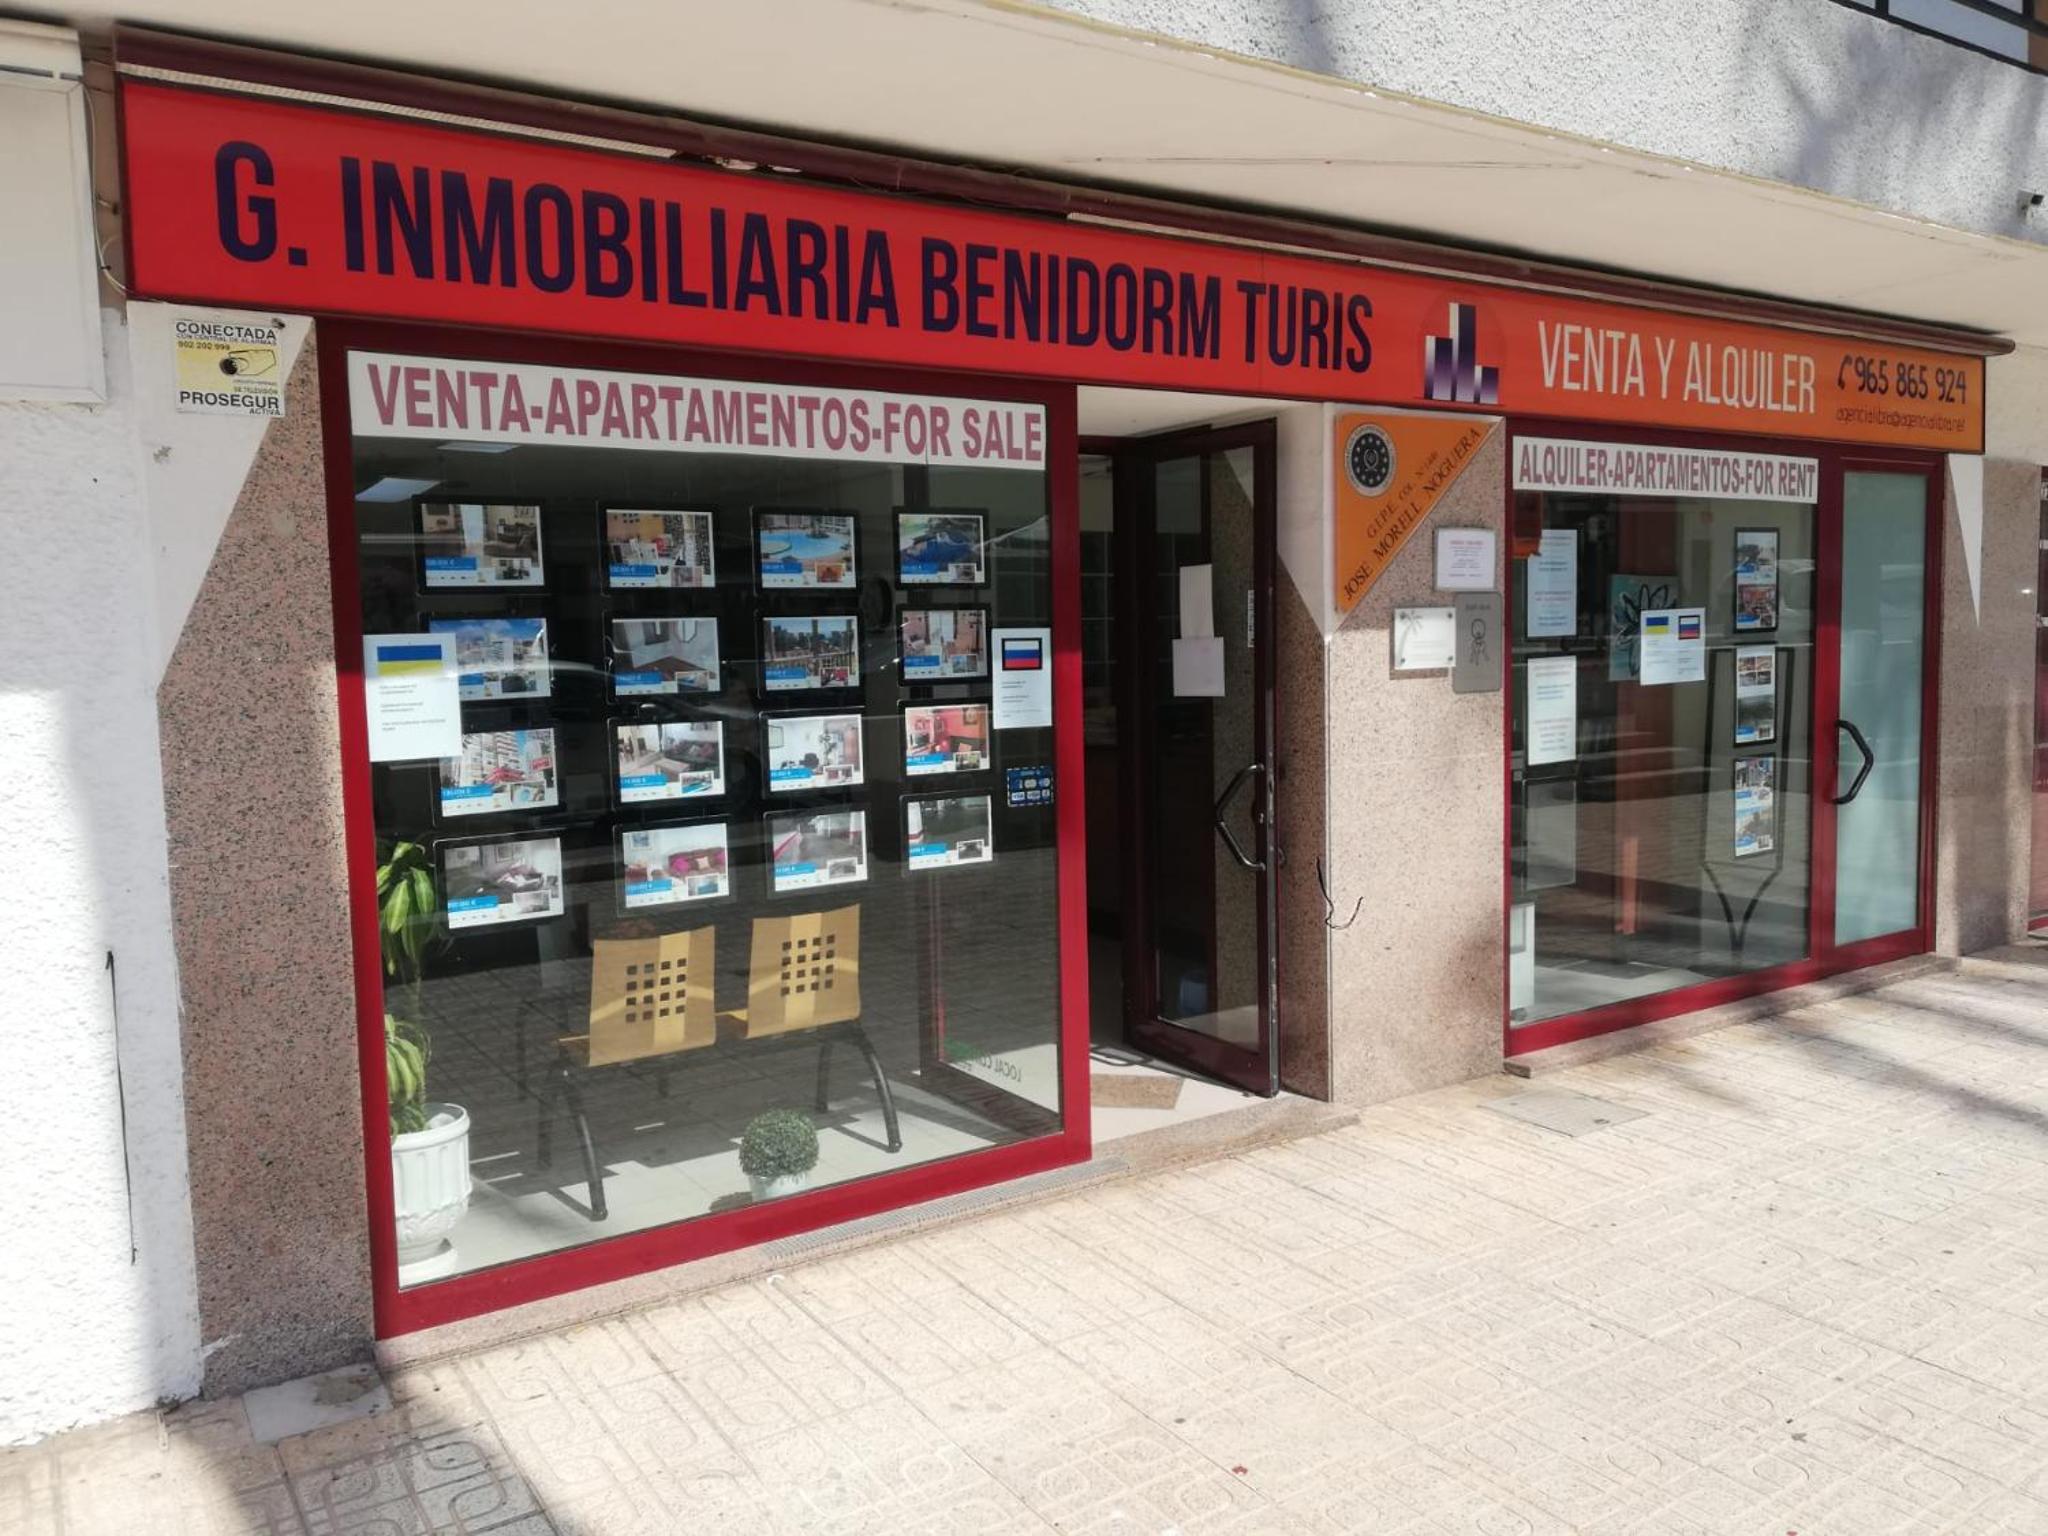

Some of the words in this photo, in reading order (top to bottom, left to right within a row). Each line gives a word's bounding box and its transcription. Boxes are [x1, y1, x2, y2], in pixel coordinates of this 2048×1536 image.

[214, 140, 308, 266] G.
[340, 156, 900, 328] INMOBILIARIA
[921, 237, 1220, 360] BENIDORM
[1237, 280, 1373, 374] TURIS
[175, 321, 277, 341] CONECTADA
[1538, 320, 1646, 396] VENTA
[1655, 336, 1676, 399] Y
[1684, 341, 1816, 415] ALQUILER
[179, 391, 280, 409] PROSEGUR
[367, 362, 952, 458] VENTA-APARTAMENTOS-FOR
[962, 408, 1043, 461] SALE
[1854, 355, 1889, 395] 965
[1896, 361, 1929, 400] 865
[1935, 367, 1966, 405] 924
[1519, 443, 1777, 497] ALQUILER-APARTAMENTOS-FOR
[1778, 462, 1817, 499] RENT
[1343, 560, 1375, 602] JOSE
[1372, 501, 1422, 562] MORELL
[1422, 427, 1482, 497] NOGUERA
